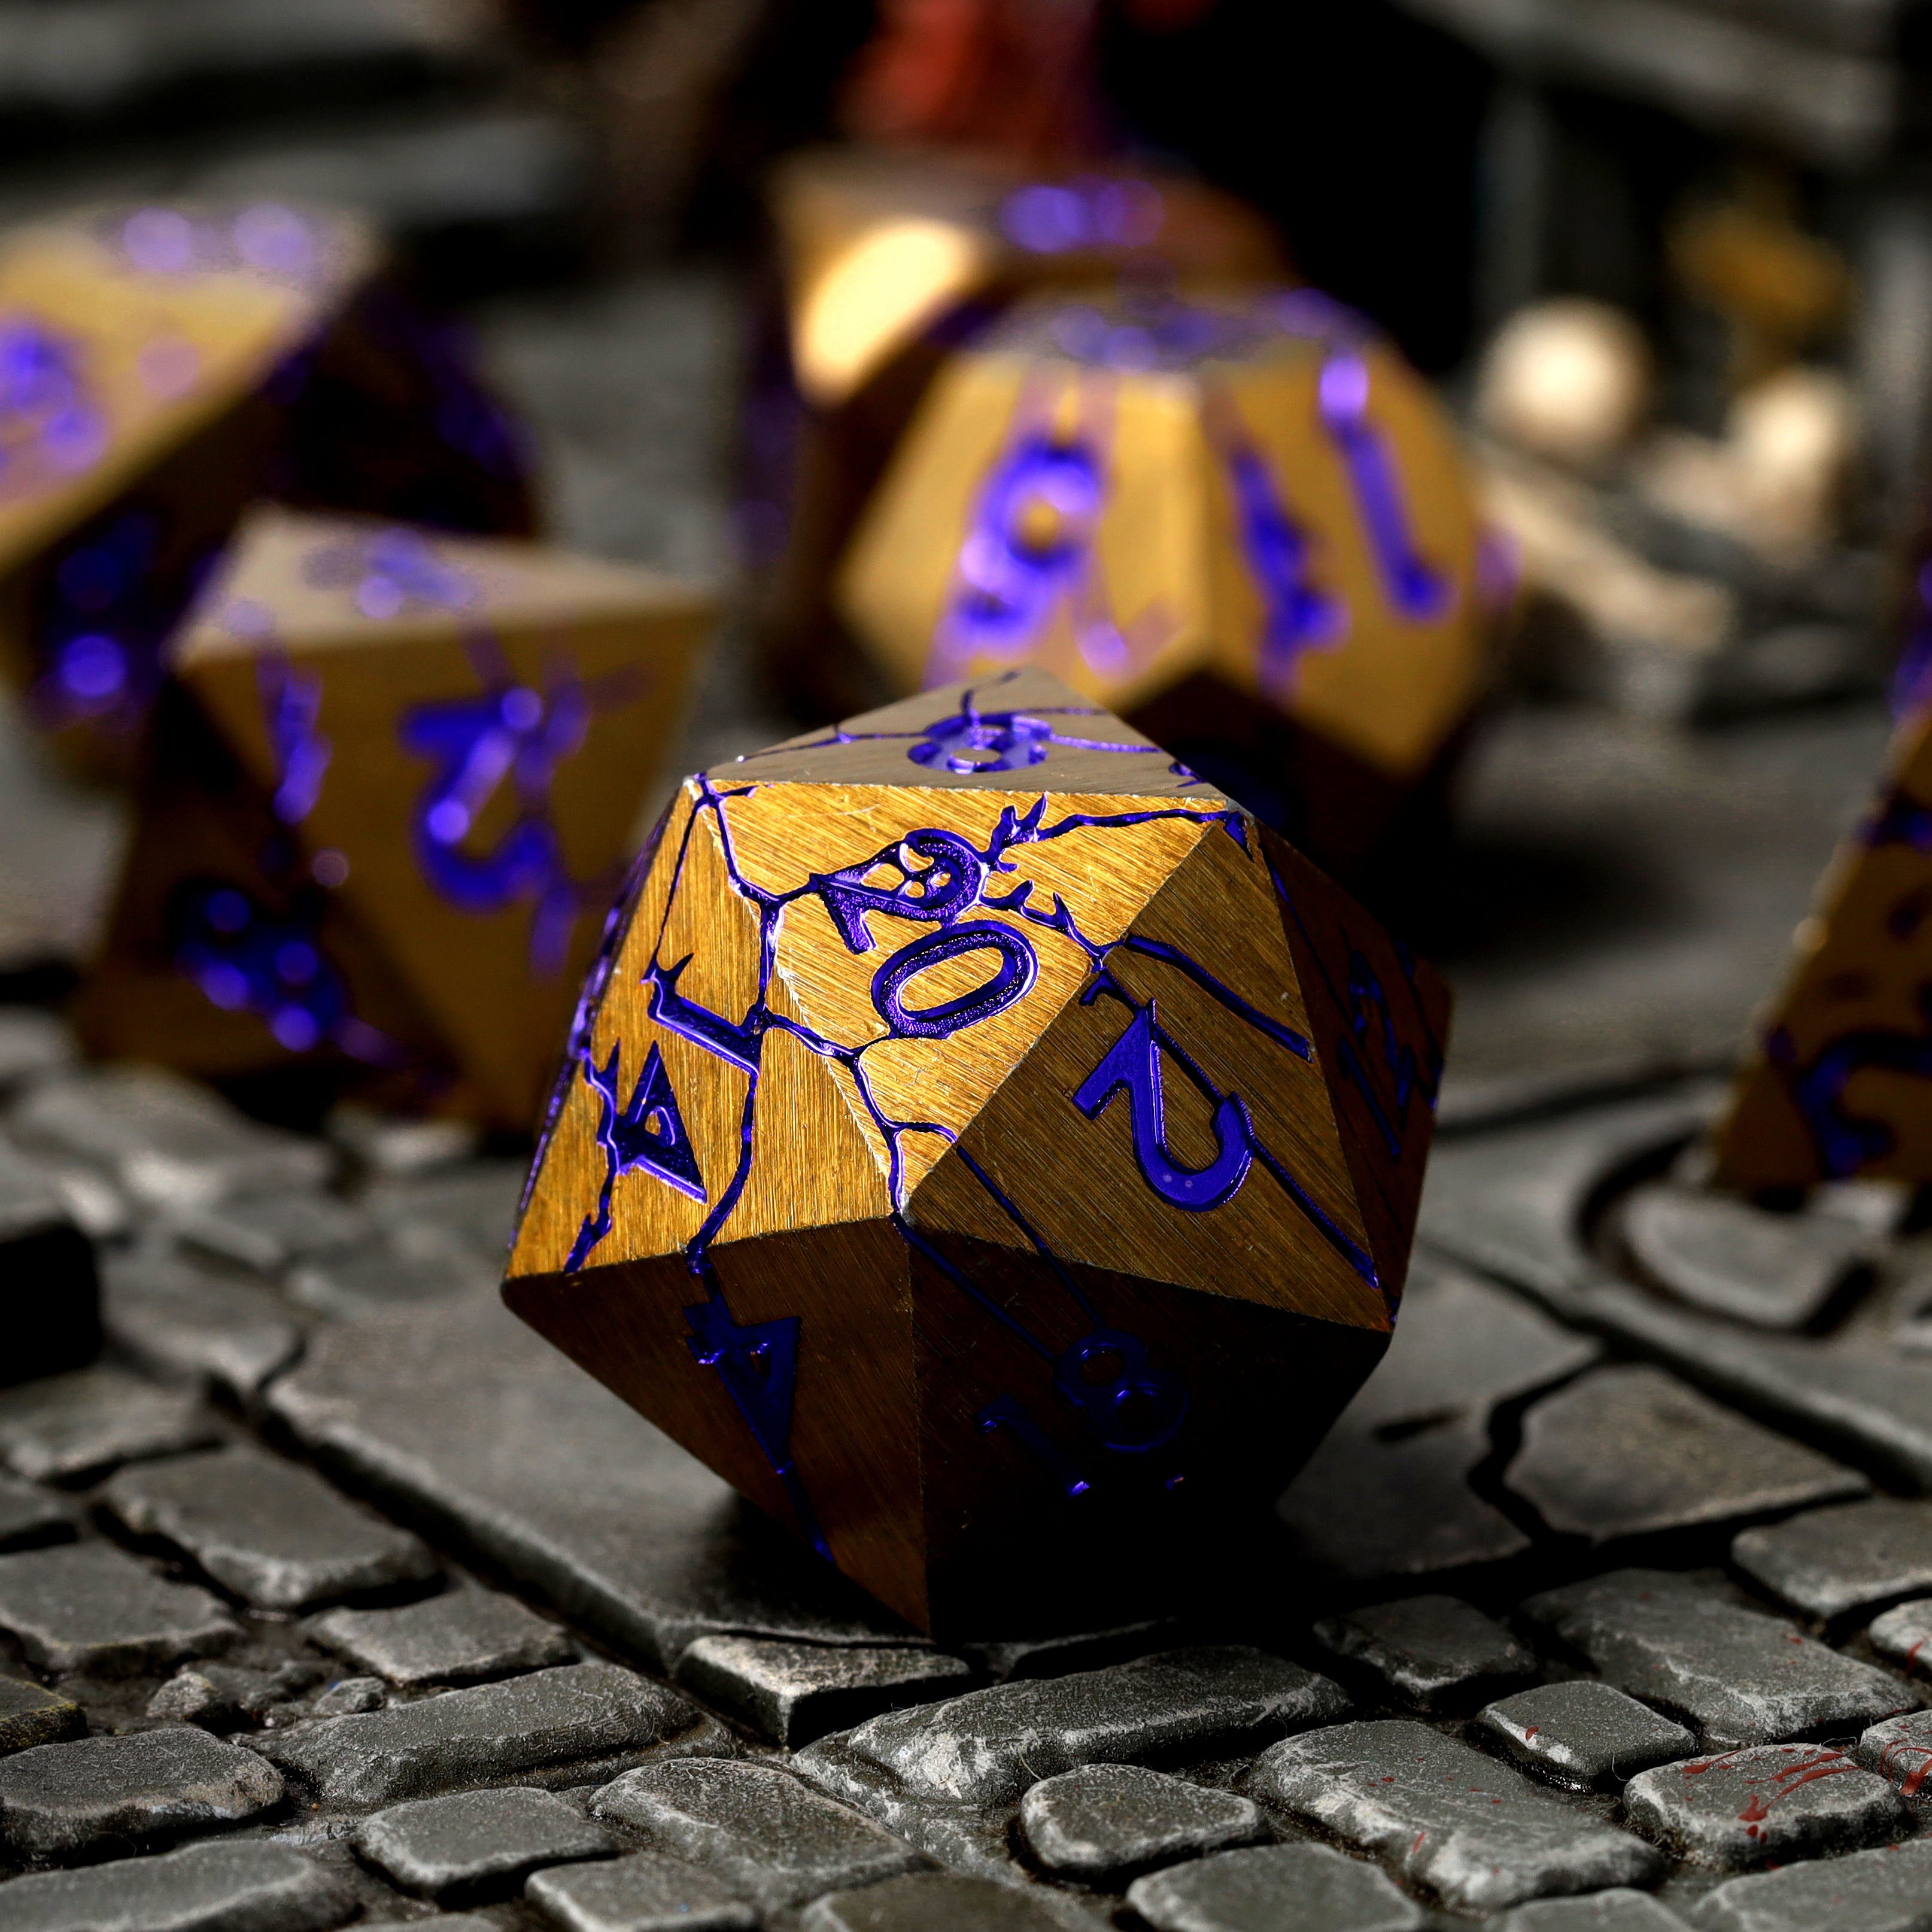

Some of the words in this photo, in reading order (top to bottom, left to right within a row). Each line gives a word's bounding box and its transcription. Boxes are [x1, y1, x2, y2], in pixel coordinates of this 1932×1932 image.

[809, 828, 1039, 1039] 20
[1071, 1006, 1256, 1213] 2
[682, 1302, 802, 1475] 4
[973, 1328, 1192, 1499] 18
